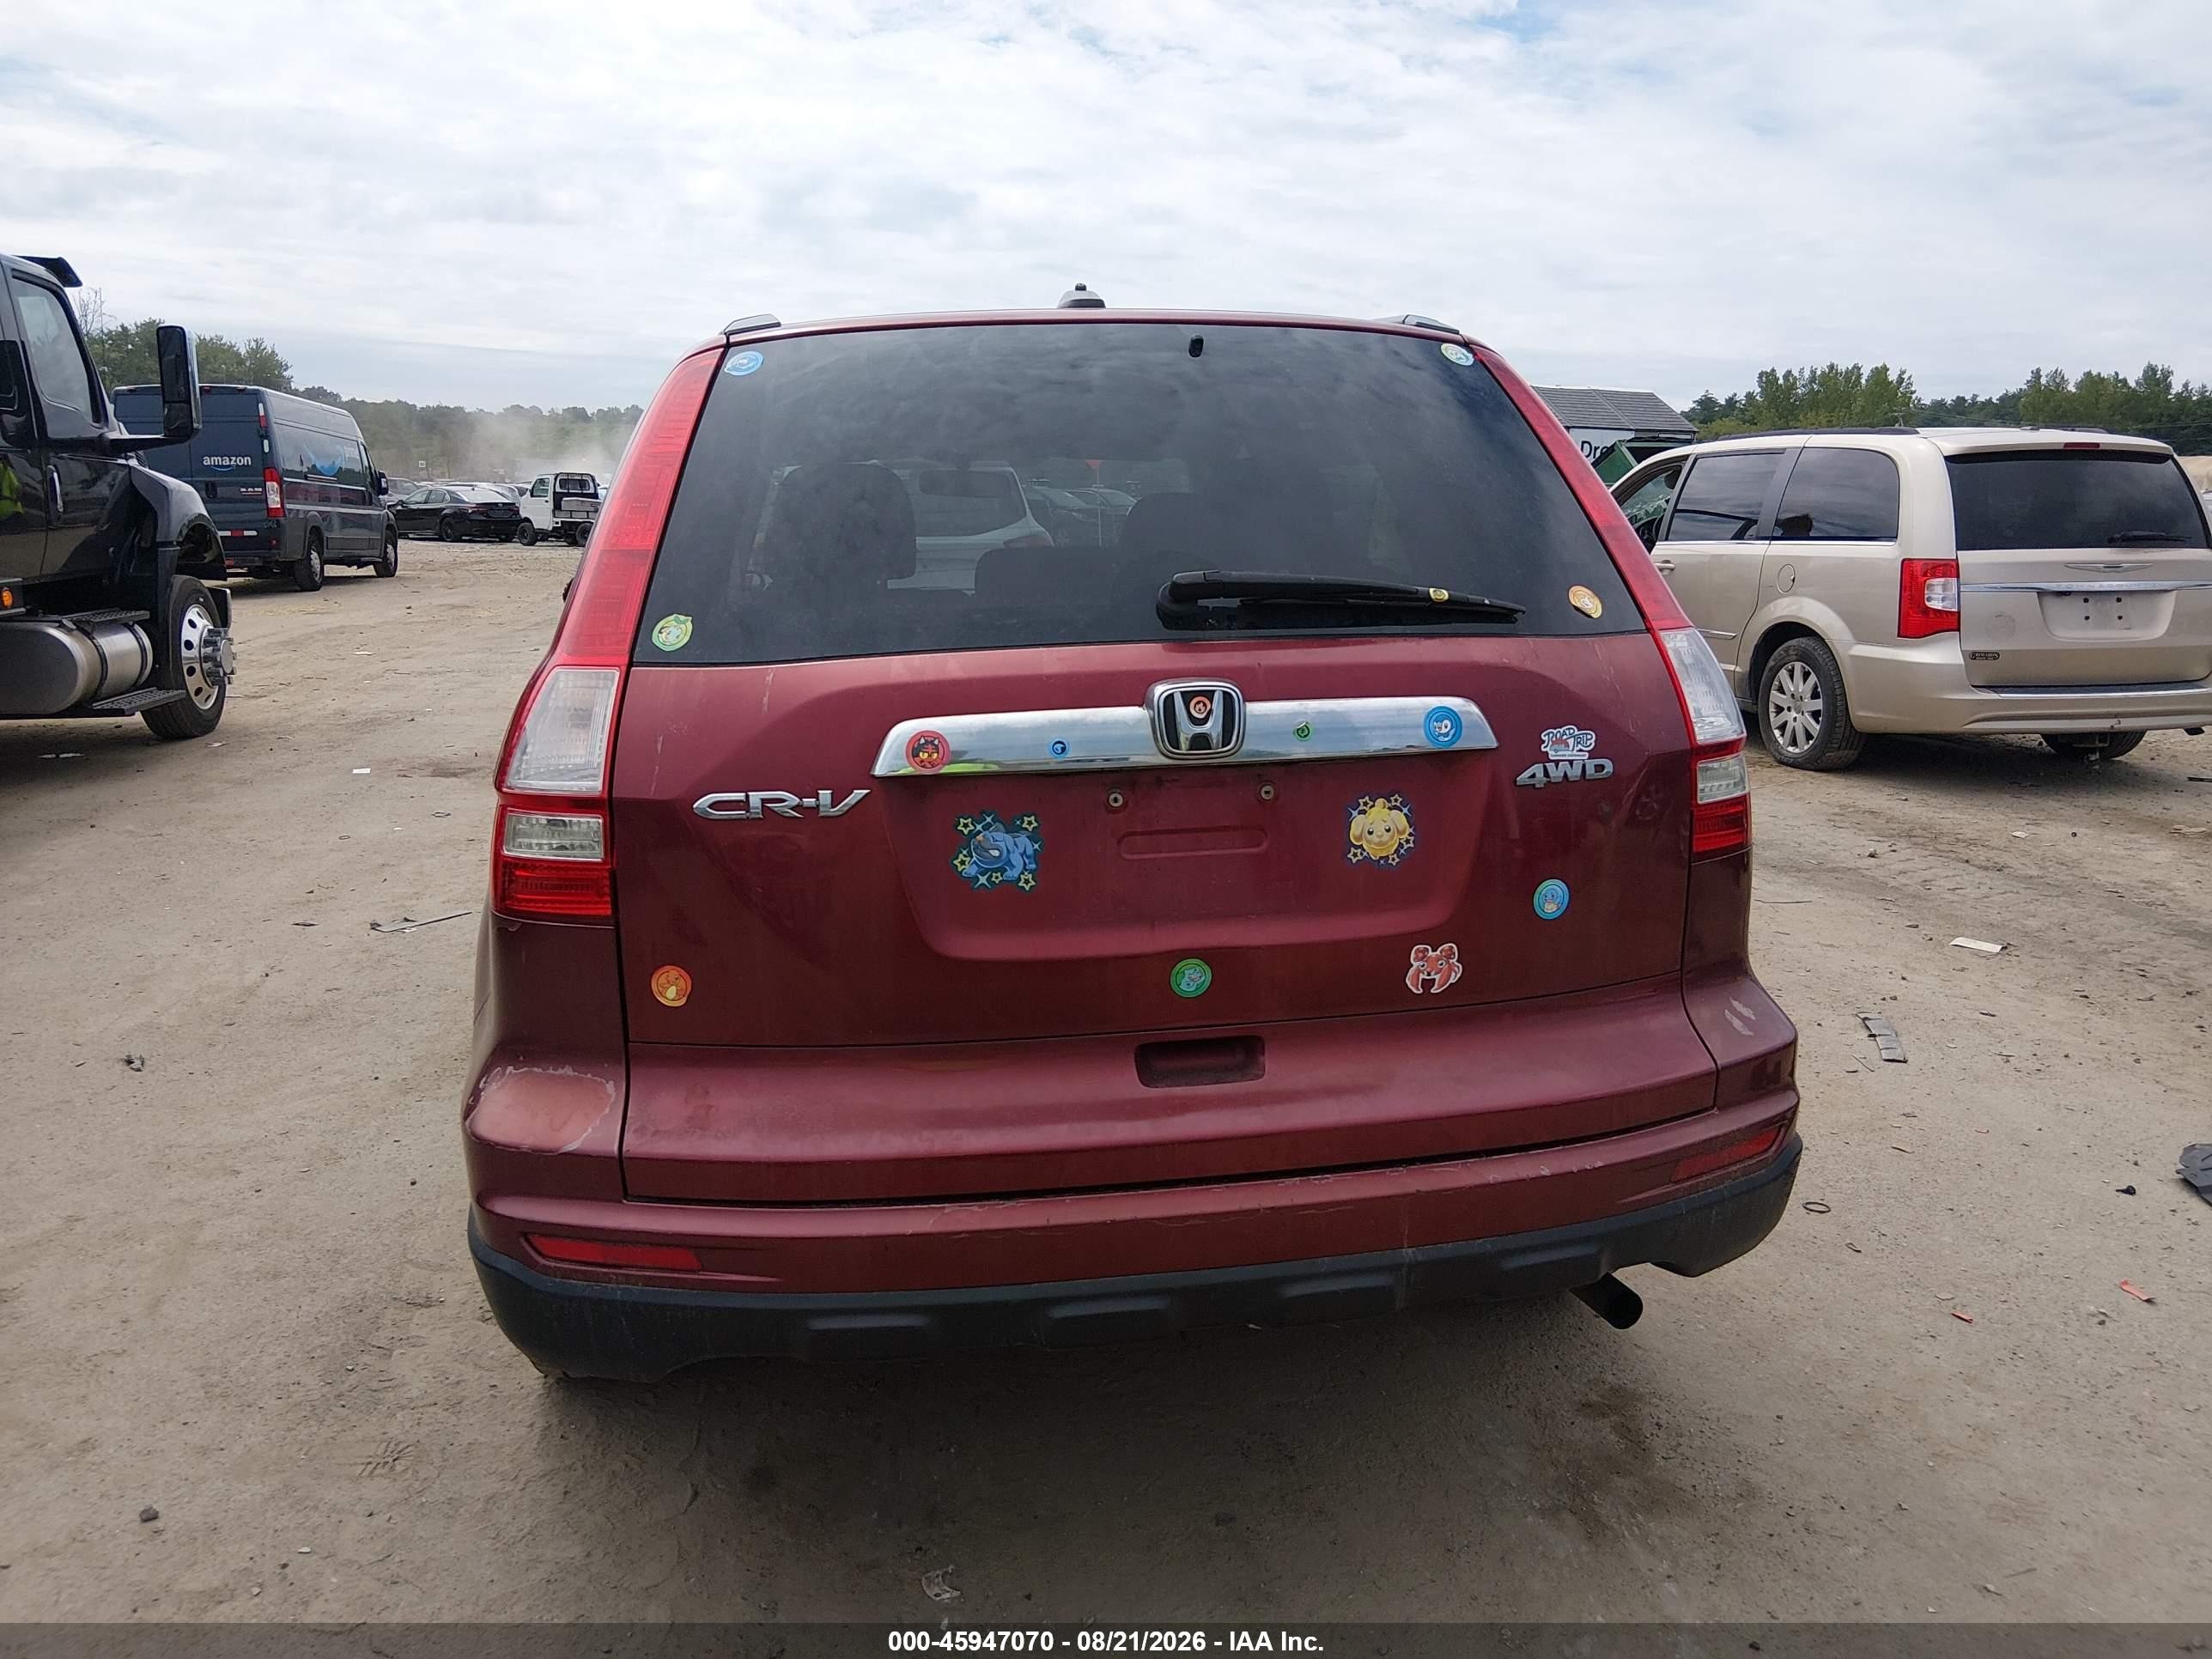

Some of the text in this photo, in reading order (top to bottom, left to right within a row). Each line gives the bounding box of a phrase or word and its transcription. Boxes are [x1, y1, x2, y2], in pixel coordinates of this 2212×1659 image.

[203, 456, 252, 465] amazon
[1565, 732, 1593, 751] TRIP
[1516, 759, 1613, 787] 4WD
[693, 790, 871, 819] CR-V
